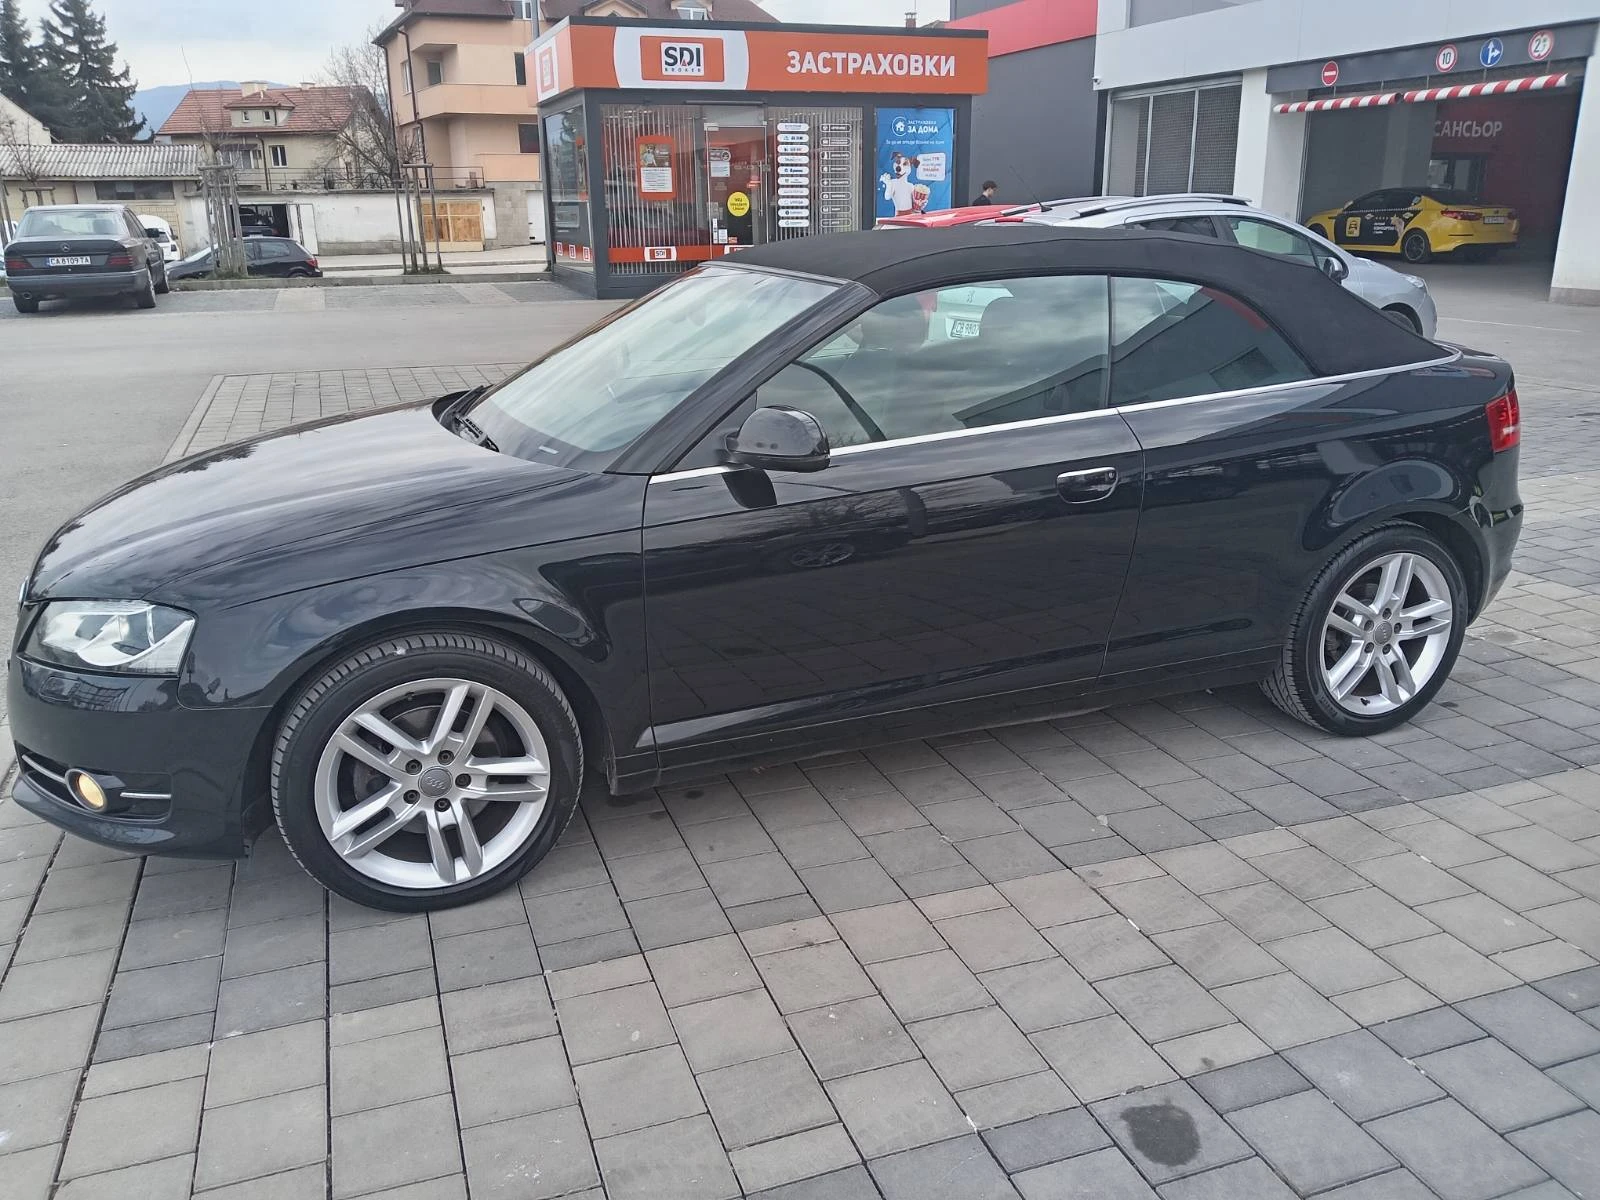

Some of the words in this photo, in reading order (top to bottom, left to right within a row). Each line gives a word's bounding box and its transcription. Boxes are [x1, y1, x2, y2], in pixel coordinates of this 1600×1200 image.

[664, 46, 701, 67] SDI
[786, 50, 955, 77] ЗАСТРАХОВКИ
[1442, 52, 1451, 65] 10
[917, 126, 939, 134] ДОМА
